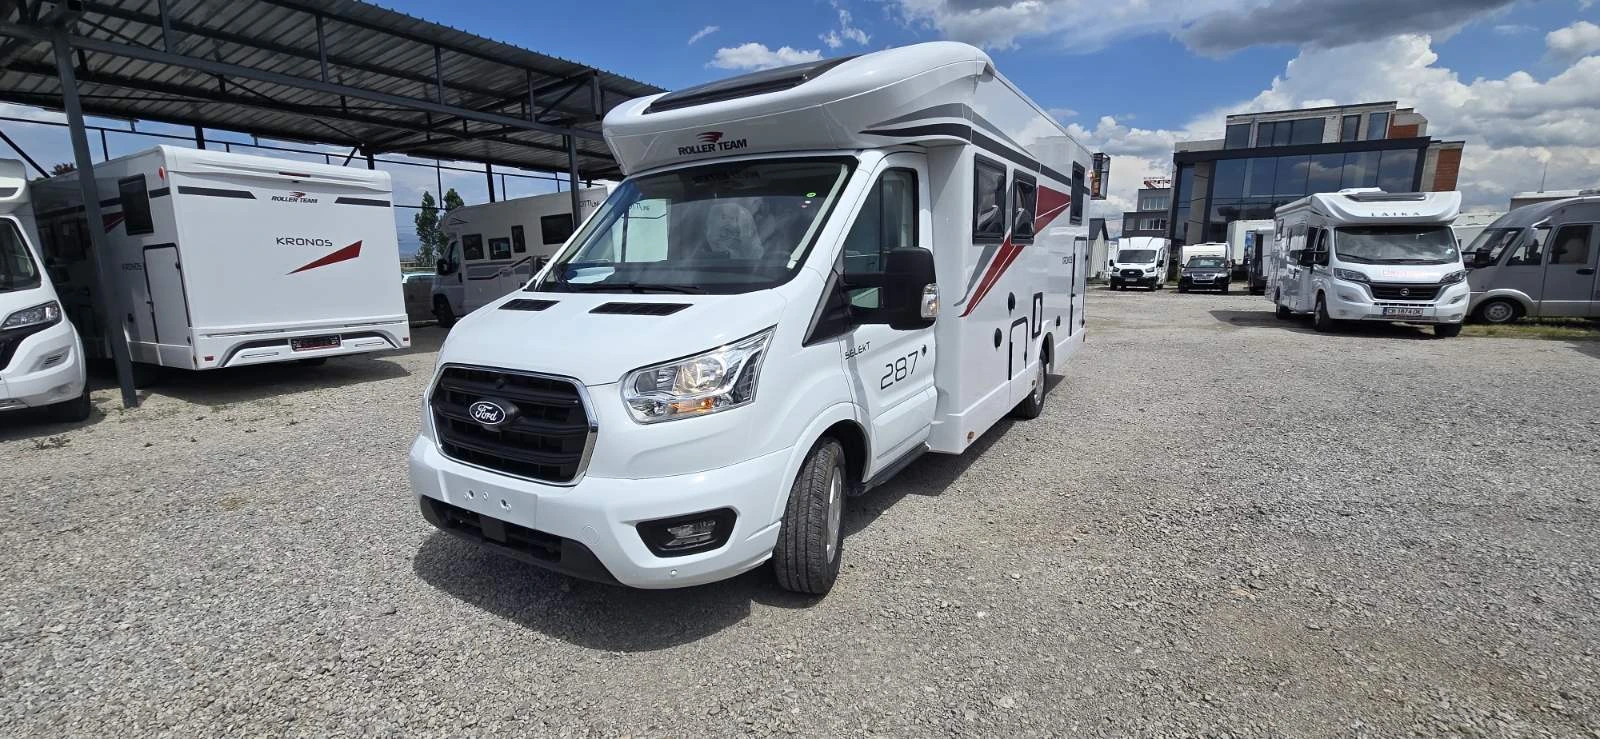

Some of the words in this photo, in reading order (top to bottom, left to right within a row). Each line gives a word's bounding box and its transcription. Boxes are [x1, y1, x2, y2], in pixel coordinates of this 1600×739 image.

[677, 143, 716, 156] ROLLER
[717, 138, 748, 151] TEAM
[271, 195, 298, 203] ROLLER
[276, 237, 333, 247] KRONOS
[880, 350, 918, 390] 287
[475, 404, 498, 421] Ford
